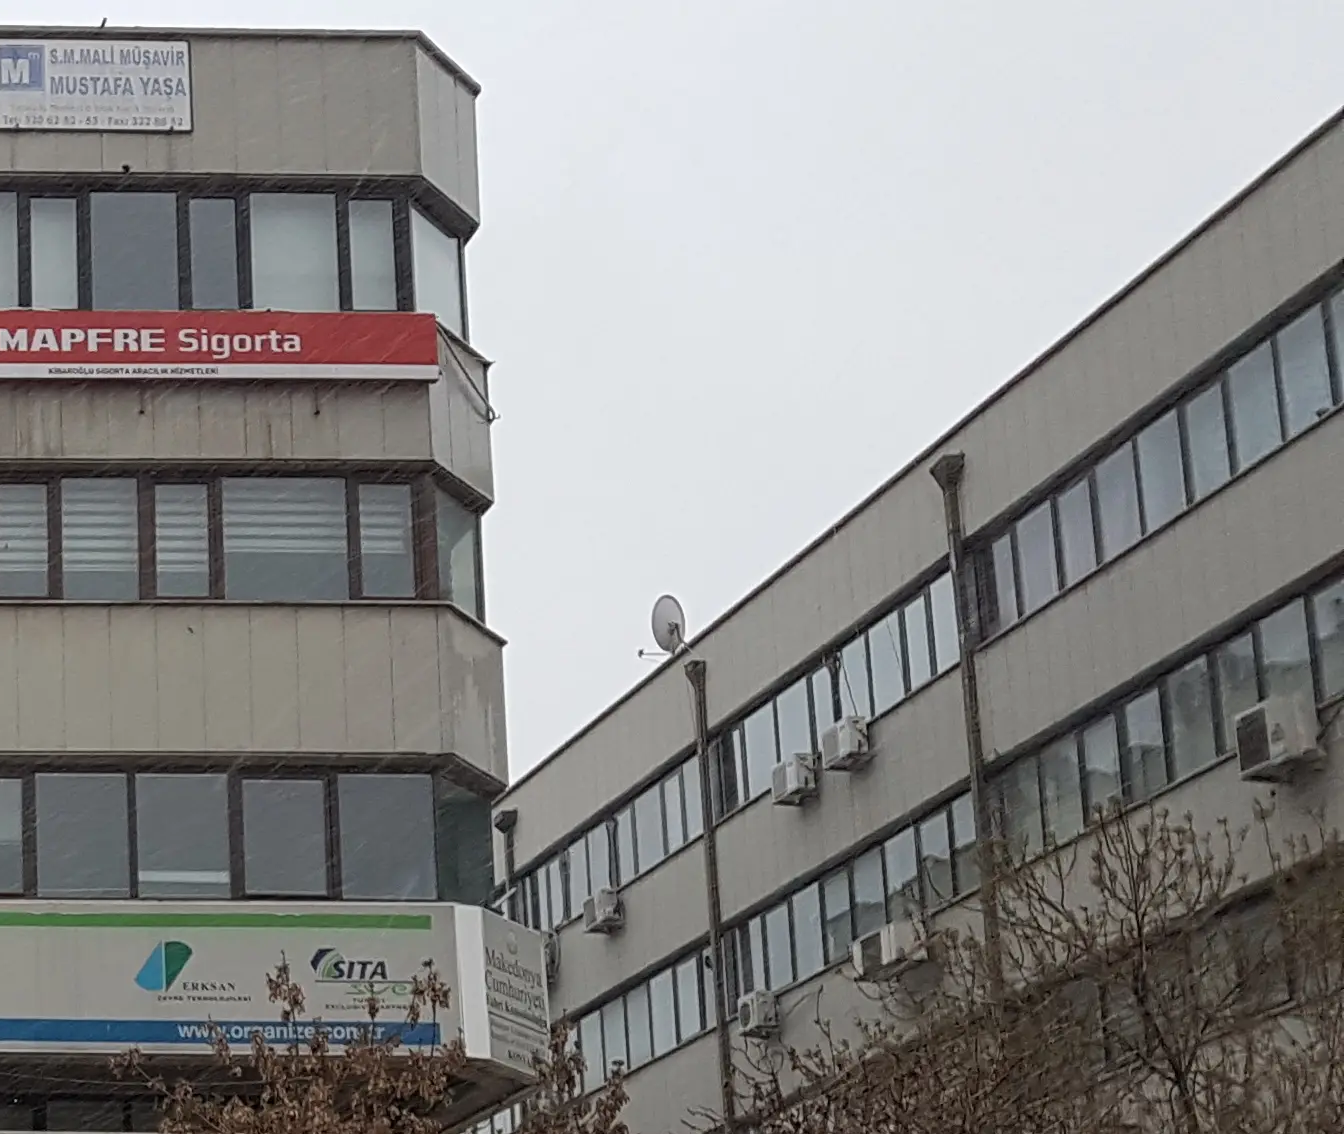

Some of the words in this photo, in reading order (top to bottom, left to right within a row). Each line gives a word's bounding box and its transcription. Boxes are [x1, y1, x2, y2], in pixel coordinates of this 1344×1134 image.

[49, 75, 135, 97] MUSTAFA
[139, 76, 187, 99] YAŞA
[178, 328, 302, 359] Sigorta
[331, 960, 388, 980] SITA
